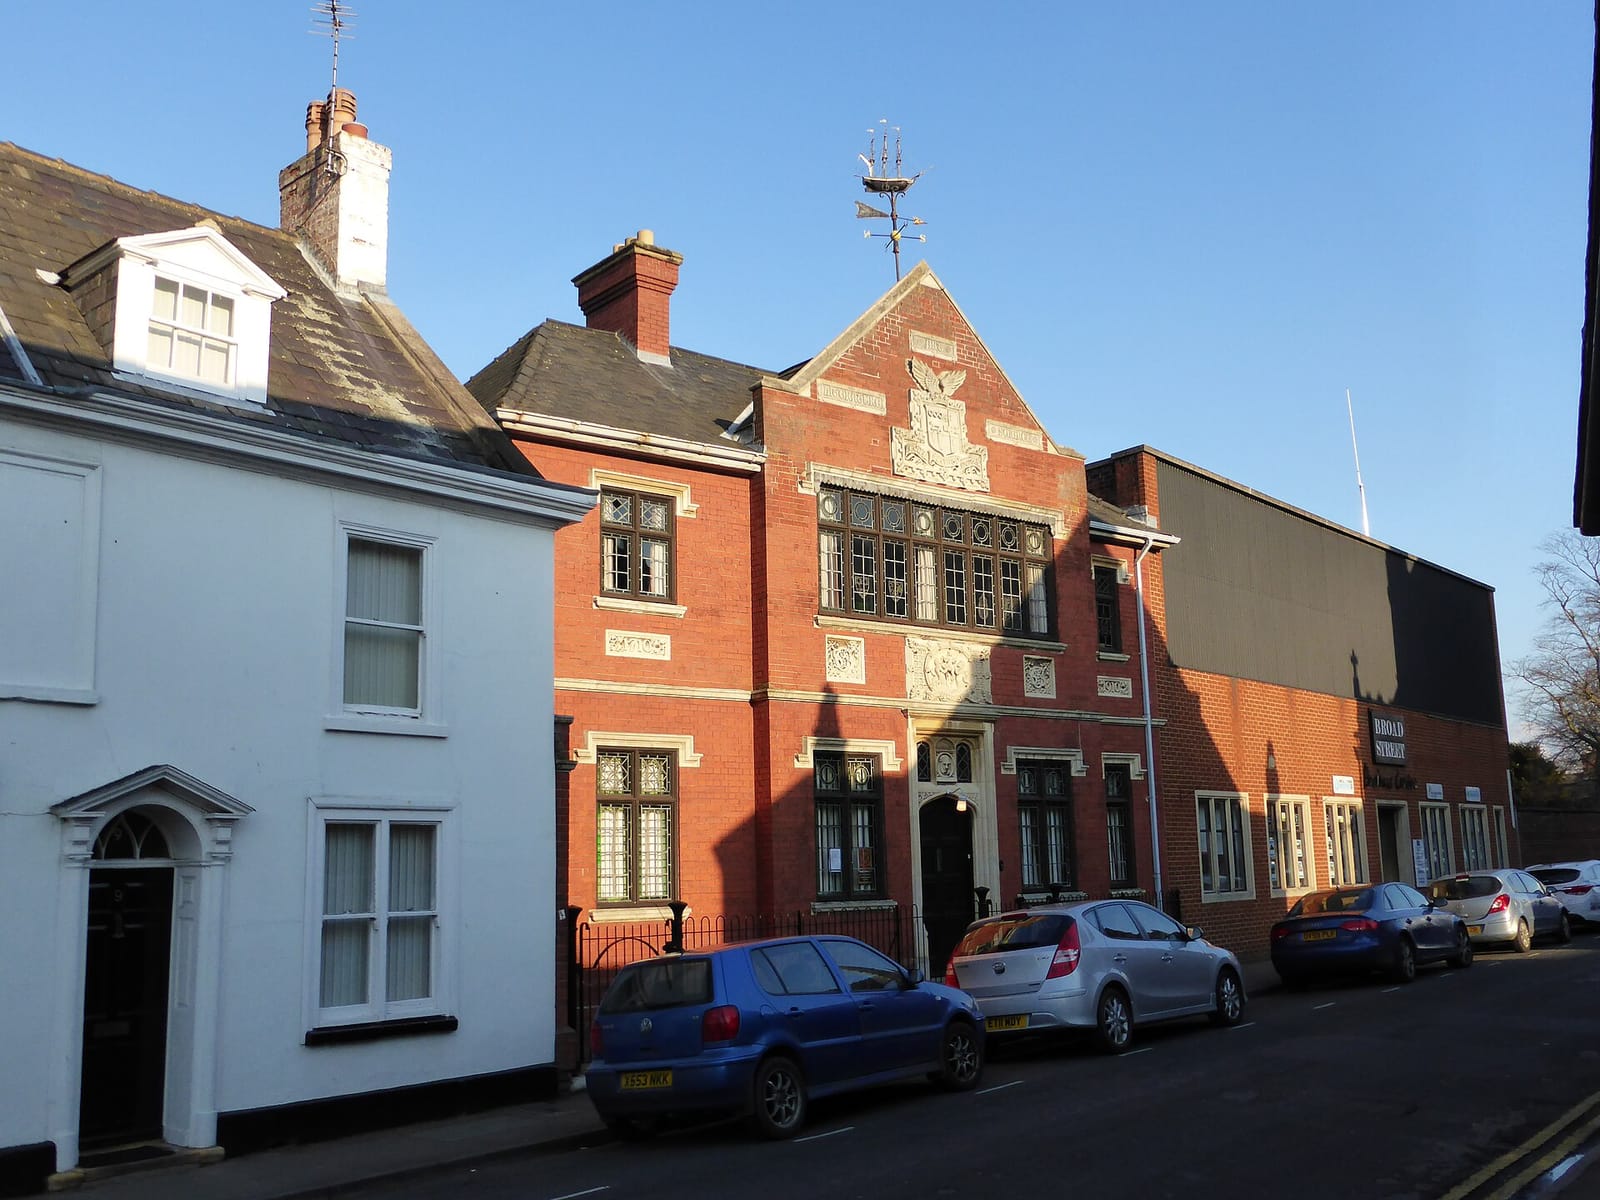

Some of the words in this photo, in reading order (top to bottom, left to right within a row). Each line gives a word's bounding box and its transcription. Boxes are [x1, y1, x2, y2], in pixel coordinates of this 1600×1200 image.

[1374, 718, 1404, 738] BROAD
[1375, 740, 1405, 759] STREET
[113, 889, 124, 903] 9
